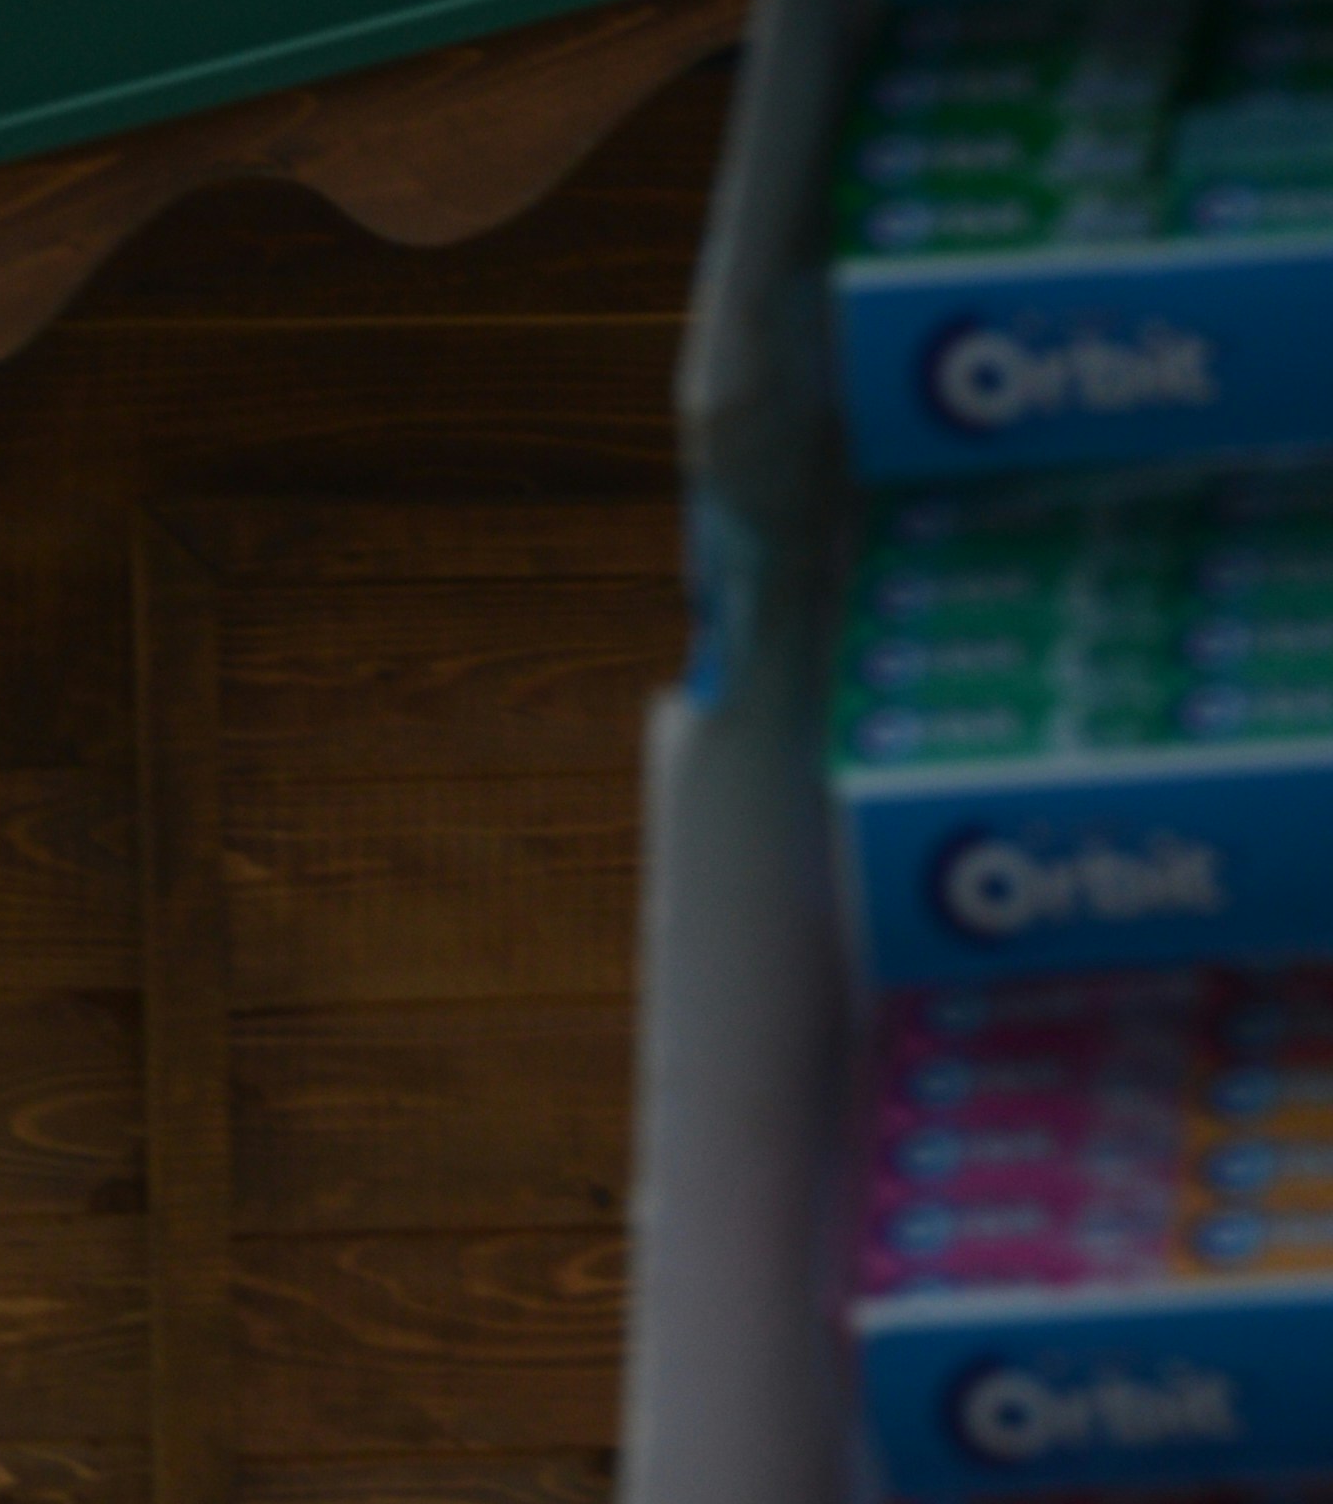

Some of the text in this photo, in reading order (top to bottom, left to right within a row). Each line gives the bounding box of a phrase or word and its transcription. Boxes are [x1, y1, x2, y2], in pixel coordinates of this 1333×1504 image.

[933, 326, 1221, 431] Orbit
[942, 834, 1231, 936] Orbit
[963, 1364, 1246, 1464] Orbit
